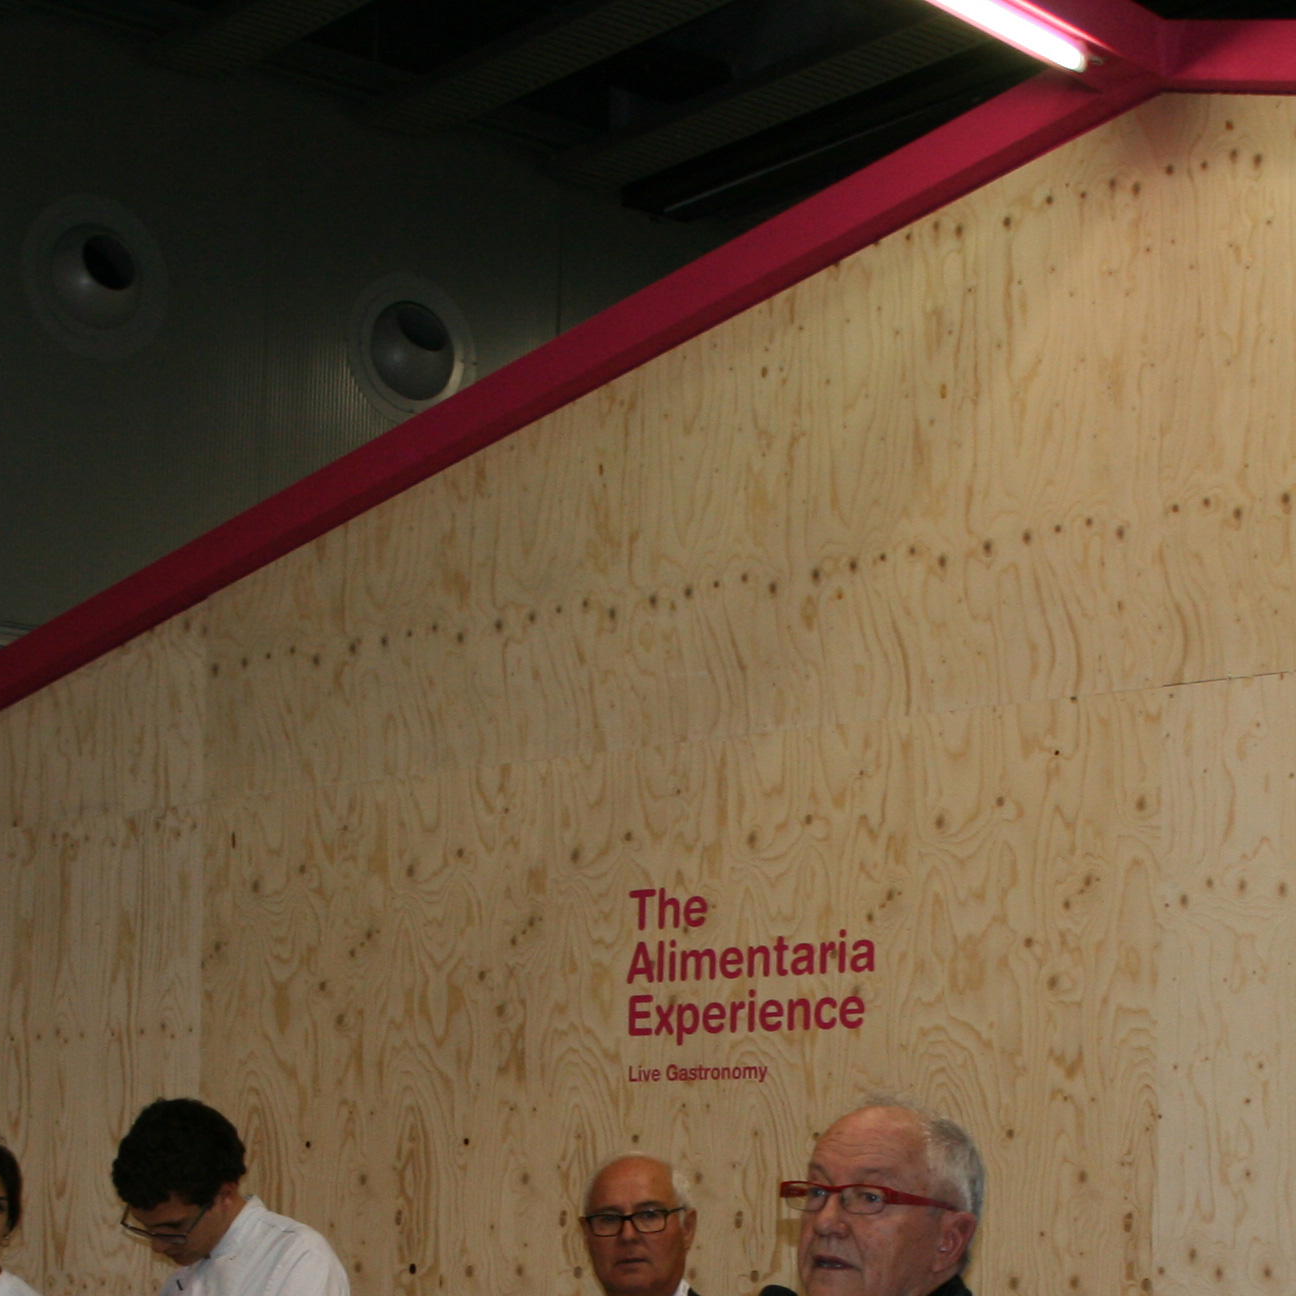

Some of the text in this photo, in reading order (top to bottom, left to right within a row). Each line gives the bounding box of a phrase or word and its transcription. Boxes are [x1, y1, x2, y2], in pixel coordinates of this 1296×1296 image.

[629, 887, 708, 931] The
[626, 928, 875, 984] Alimentaria
[627, 989, 865, 1046] Experience
[628, 1064, 768, 1083] Live Gastronomy
